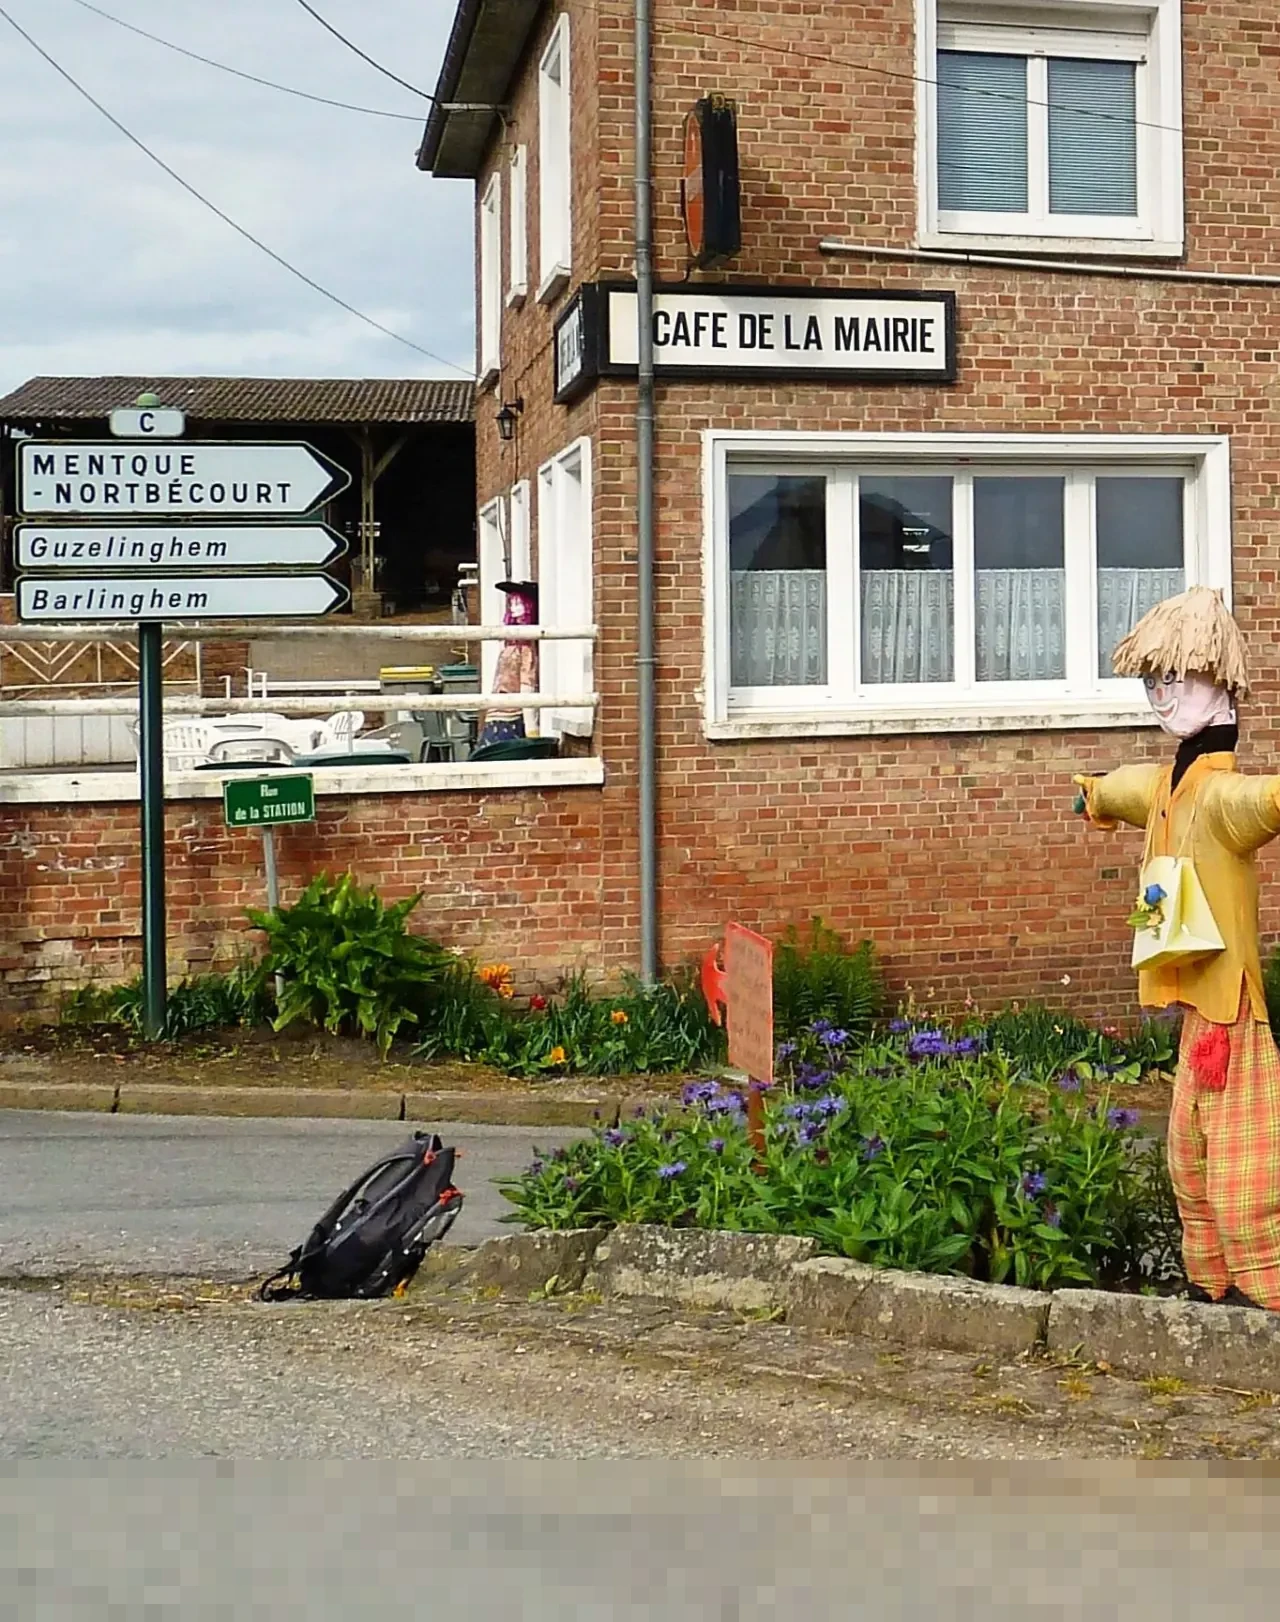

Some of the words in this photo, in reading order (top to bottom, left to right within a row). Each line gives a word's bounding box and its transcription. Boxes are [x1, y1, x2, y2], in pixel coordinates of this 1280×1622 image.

[652, 309, 729, 349] CAFE
[738, 312, 775, 351] DE
[784, 313, 823, 352] LA
[834, 315, 935, 354] MAIRIE
[138, 411, 155, 434] C
[33, 454, 197, 475] MENTQUE
[30, 536, 228, 563] Guzelinghem
[31, 588, 208, 615] Barlinghem
[235, 807, 247, 820] de
[250, 806, 259, 818] la
[263, 801, 305, 818] STATION
